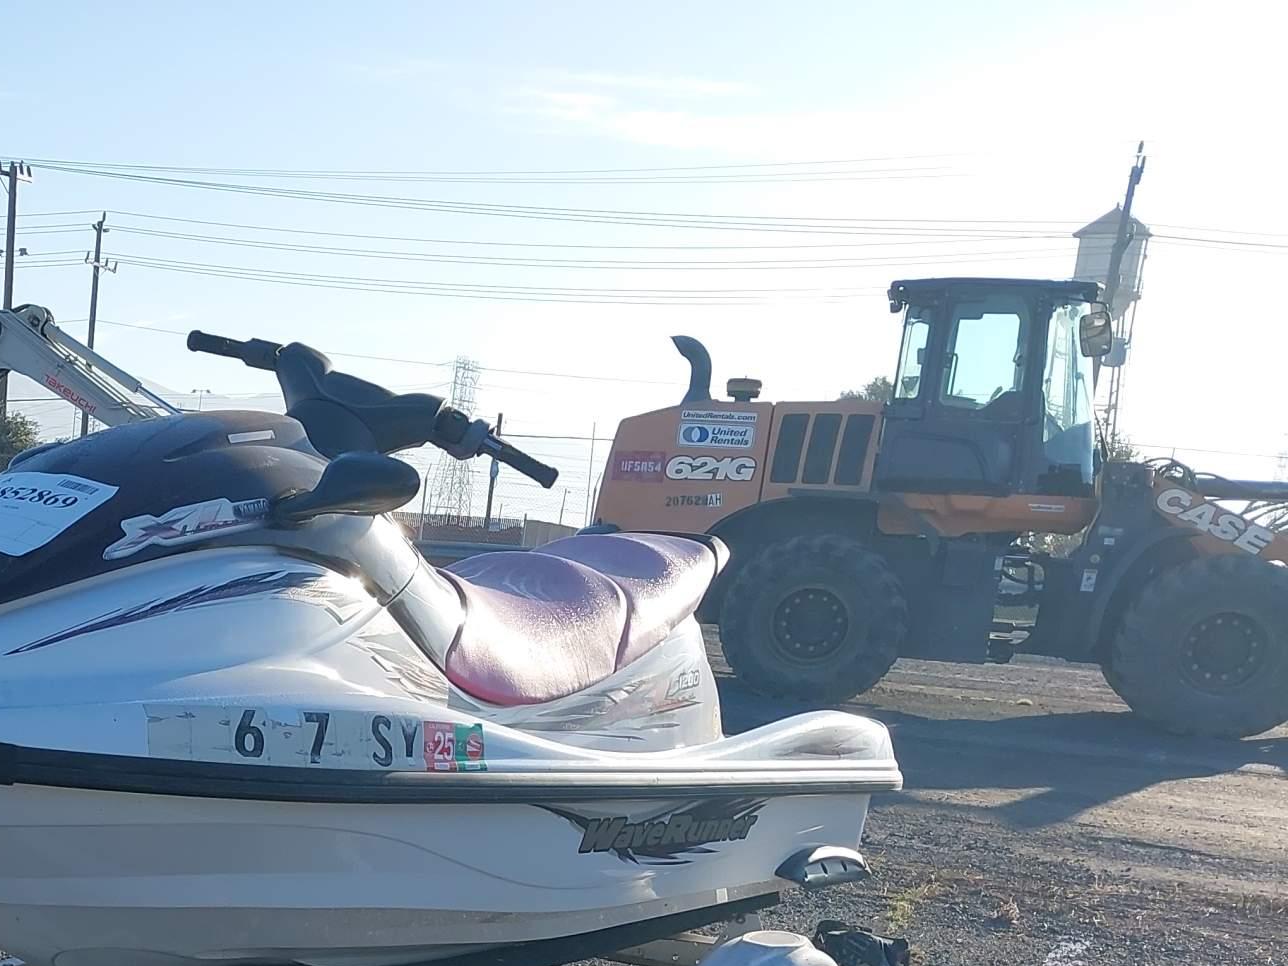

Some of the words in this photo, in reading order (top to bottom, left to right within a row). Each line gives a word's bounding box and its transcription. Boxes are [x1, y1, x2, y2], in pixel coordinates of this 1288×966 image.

[682, 411, 756, 421] UnitedRentals.com
[710, 436, 749, 447] Rentals
[712, 427, 747, 438] United
[665, 455, 757, 481] 621G
[1157, 488, 1273, 555] CASE
[234, 709, 264, 758] 6
[303, 711, 330, 764] 7
[434, 731, 454, 761] 25
[578, 814, 759, 854] WaveRunner
